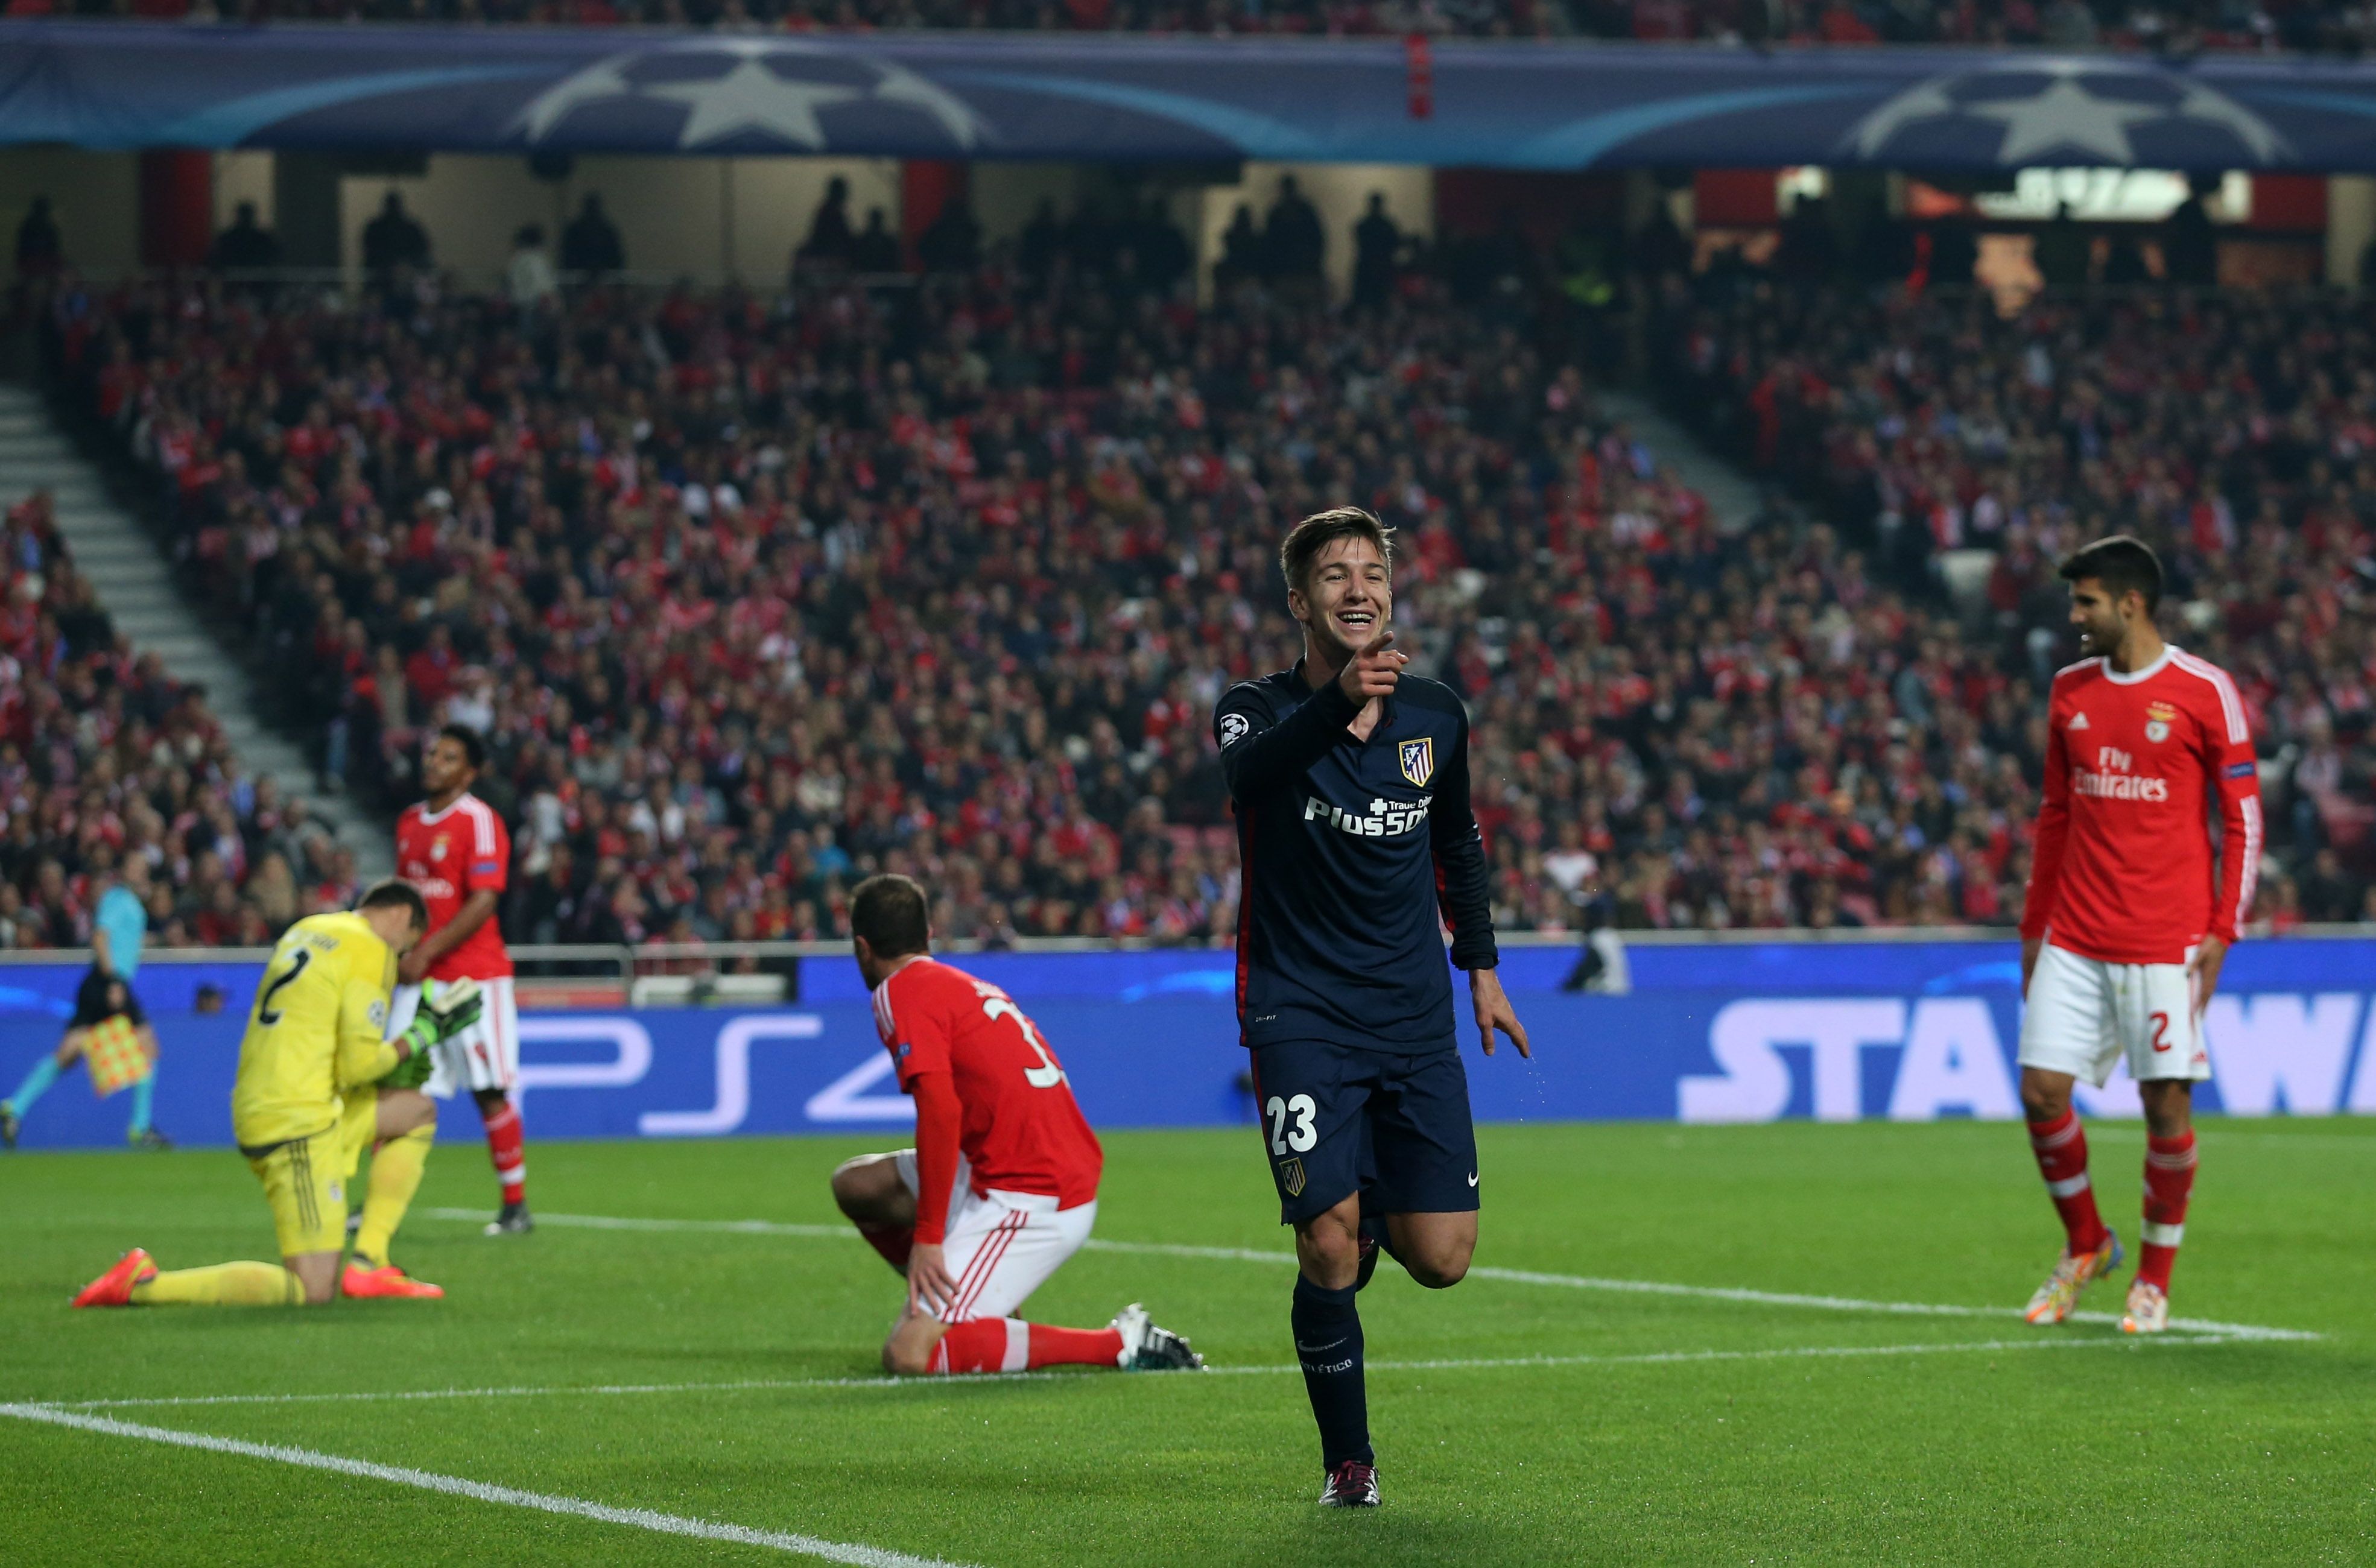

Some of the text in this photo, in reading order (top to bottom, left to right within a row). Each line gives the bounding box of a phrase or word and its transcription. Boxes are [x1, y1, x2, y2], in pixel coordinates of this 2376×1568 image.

[2074, 767, 2169, 803] Emirates
[2150, 1011, 2172, 1052] 2
[1267, 1093, 1317, 1155] 23
